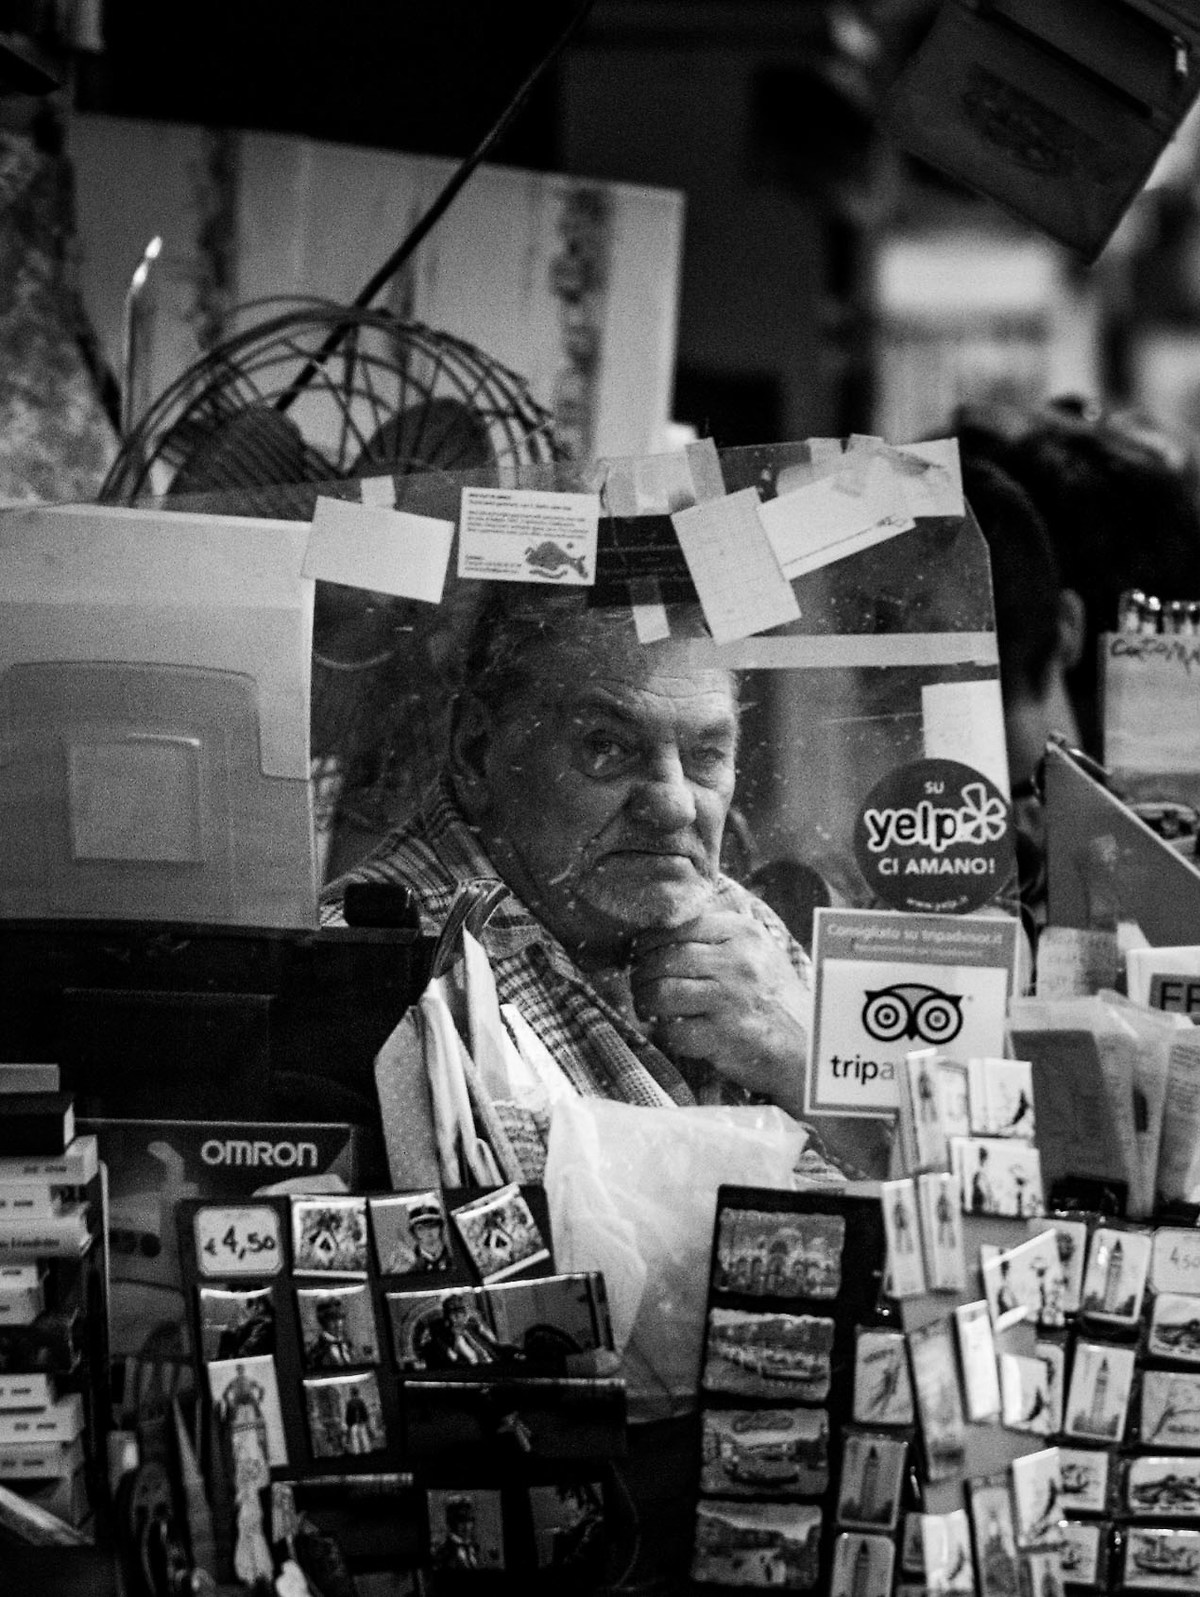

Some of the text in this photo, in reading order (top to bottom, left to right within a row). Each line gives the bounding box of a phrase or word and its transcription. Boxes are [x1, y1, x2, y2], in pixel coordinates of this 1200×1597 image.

[924, 781, 945, 795] SU
[864, 801, 959, 851] yelp
[878, 858, 996, 875] CI AMANO!
[222, 1225, 276, 1260] 4,50
